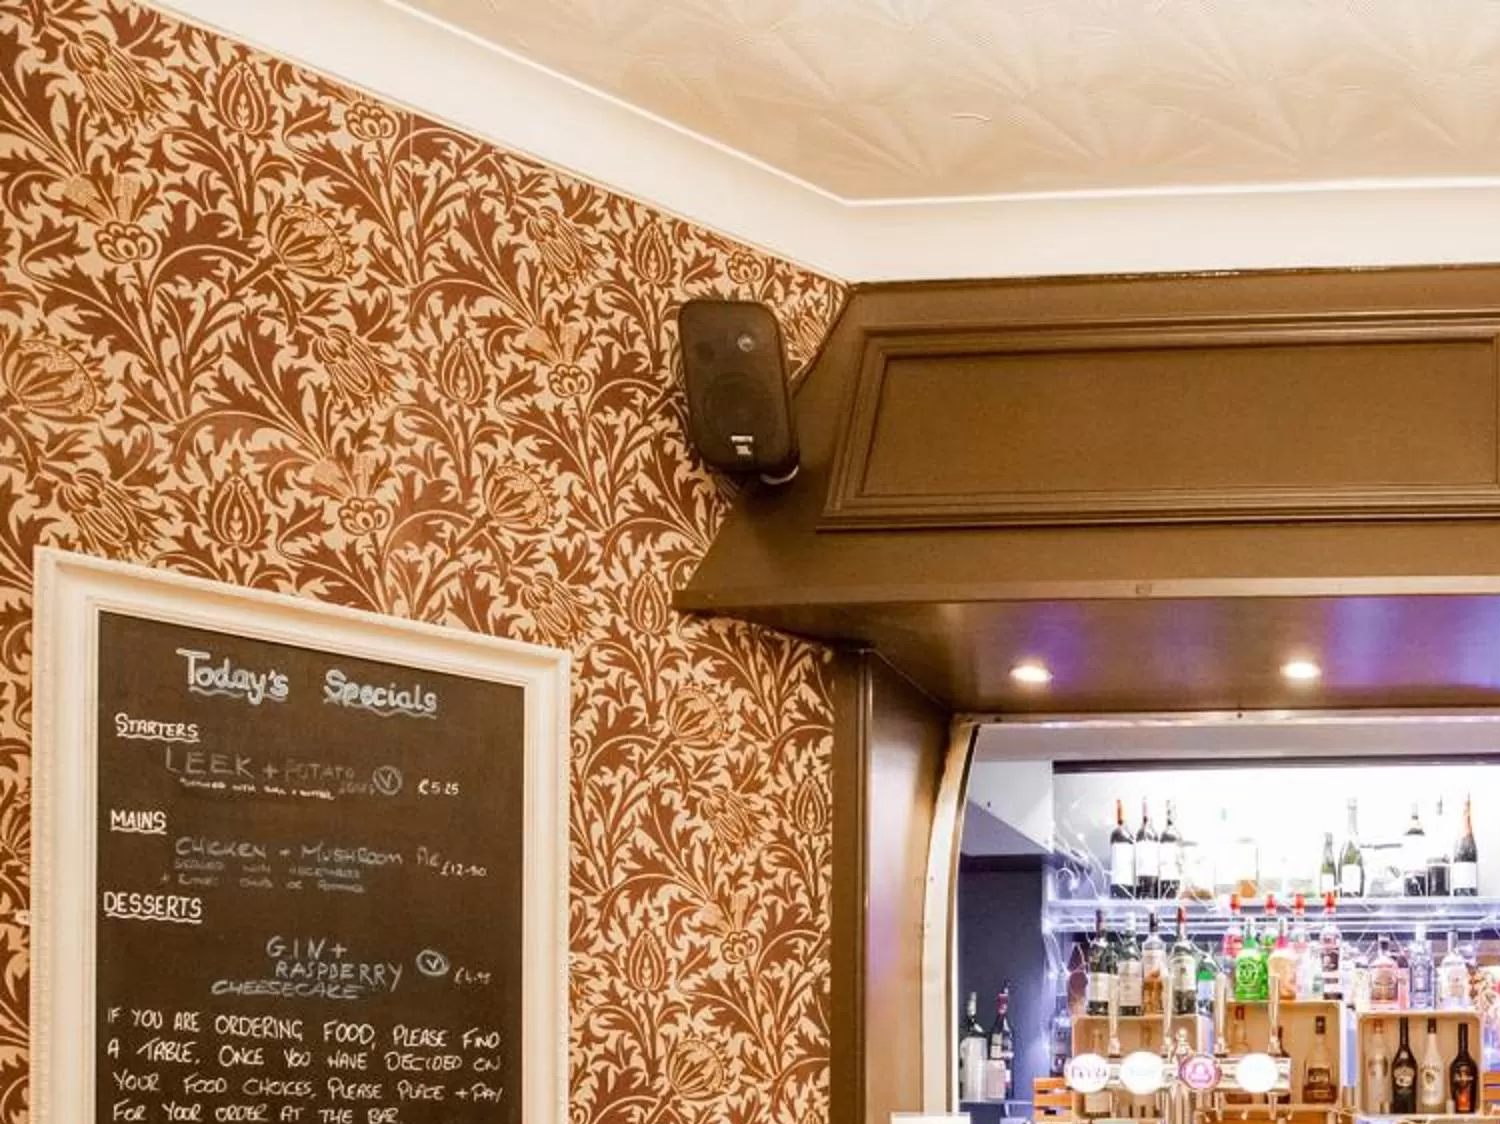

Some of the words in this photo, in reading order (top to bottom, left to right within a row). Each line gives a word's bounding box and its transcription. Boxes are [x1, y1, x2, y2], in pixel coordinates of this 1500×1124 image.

[176, 648, 289, 704] Today's
[323, 669, 437, 713] Specials
[115, 712, 199, 739] STARTERS
[165, 745, 255, 779] LEEK
[262, 763, 279, 780] +
[284, 758, 355, 782] POTATO
[110, 809, 167, 831] MAINS
[175, 836, 266, 859] CHICKEN
[301, 840, 403, 865] MUSHROOM
[104, 891, 202, 918] DESSERTS
[266, 935, 325, 960] GIN
[211, 979, 366, 1000] CHEESECAKE
[275, 960, 403, 993] RASPBERRY
[107, 1007, 121, 1024] IF
[132, 1009, 163, 1029] YOU
[173, 1011, 200, 1032] ARE
[215, 1015, 303, 1041] ORDERING
[323, 1020, 376, 1050] FOOD,
[393, 1024, 448, 1047] PLEASE
[462, 1027, 500, 1049] FIND
[107, 1037, 120, 1060] A
[218, 1045, 265, 1068] ONCE
[284, 1048, 312, 1068] YOU
[327, 1050, 369, 1072] HAVE
[384, 1051, 462, 1072] DECIDED
[473, 1056, 500, 1072] ON
[112, 1069, 160, 1092] YOUR
[183, 1072, 228, 1095] FOOD
[328, 1077, 383, 1100] PLEASE
[397, 1080, 446, 1100] PLACE
[471, 1082, 503, 1103] PAY
[112, 1099, 147, 1122] FOR
[161, 1101, 203, 1122] YOUR
[215, 1103, 269, 1122] ORDER
[280, 1105, 305, 1122] AT
[318, 1107, 353, 1124] THE
